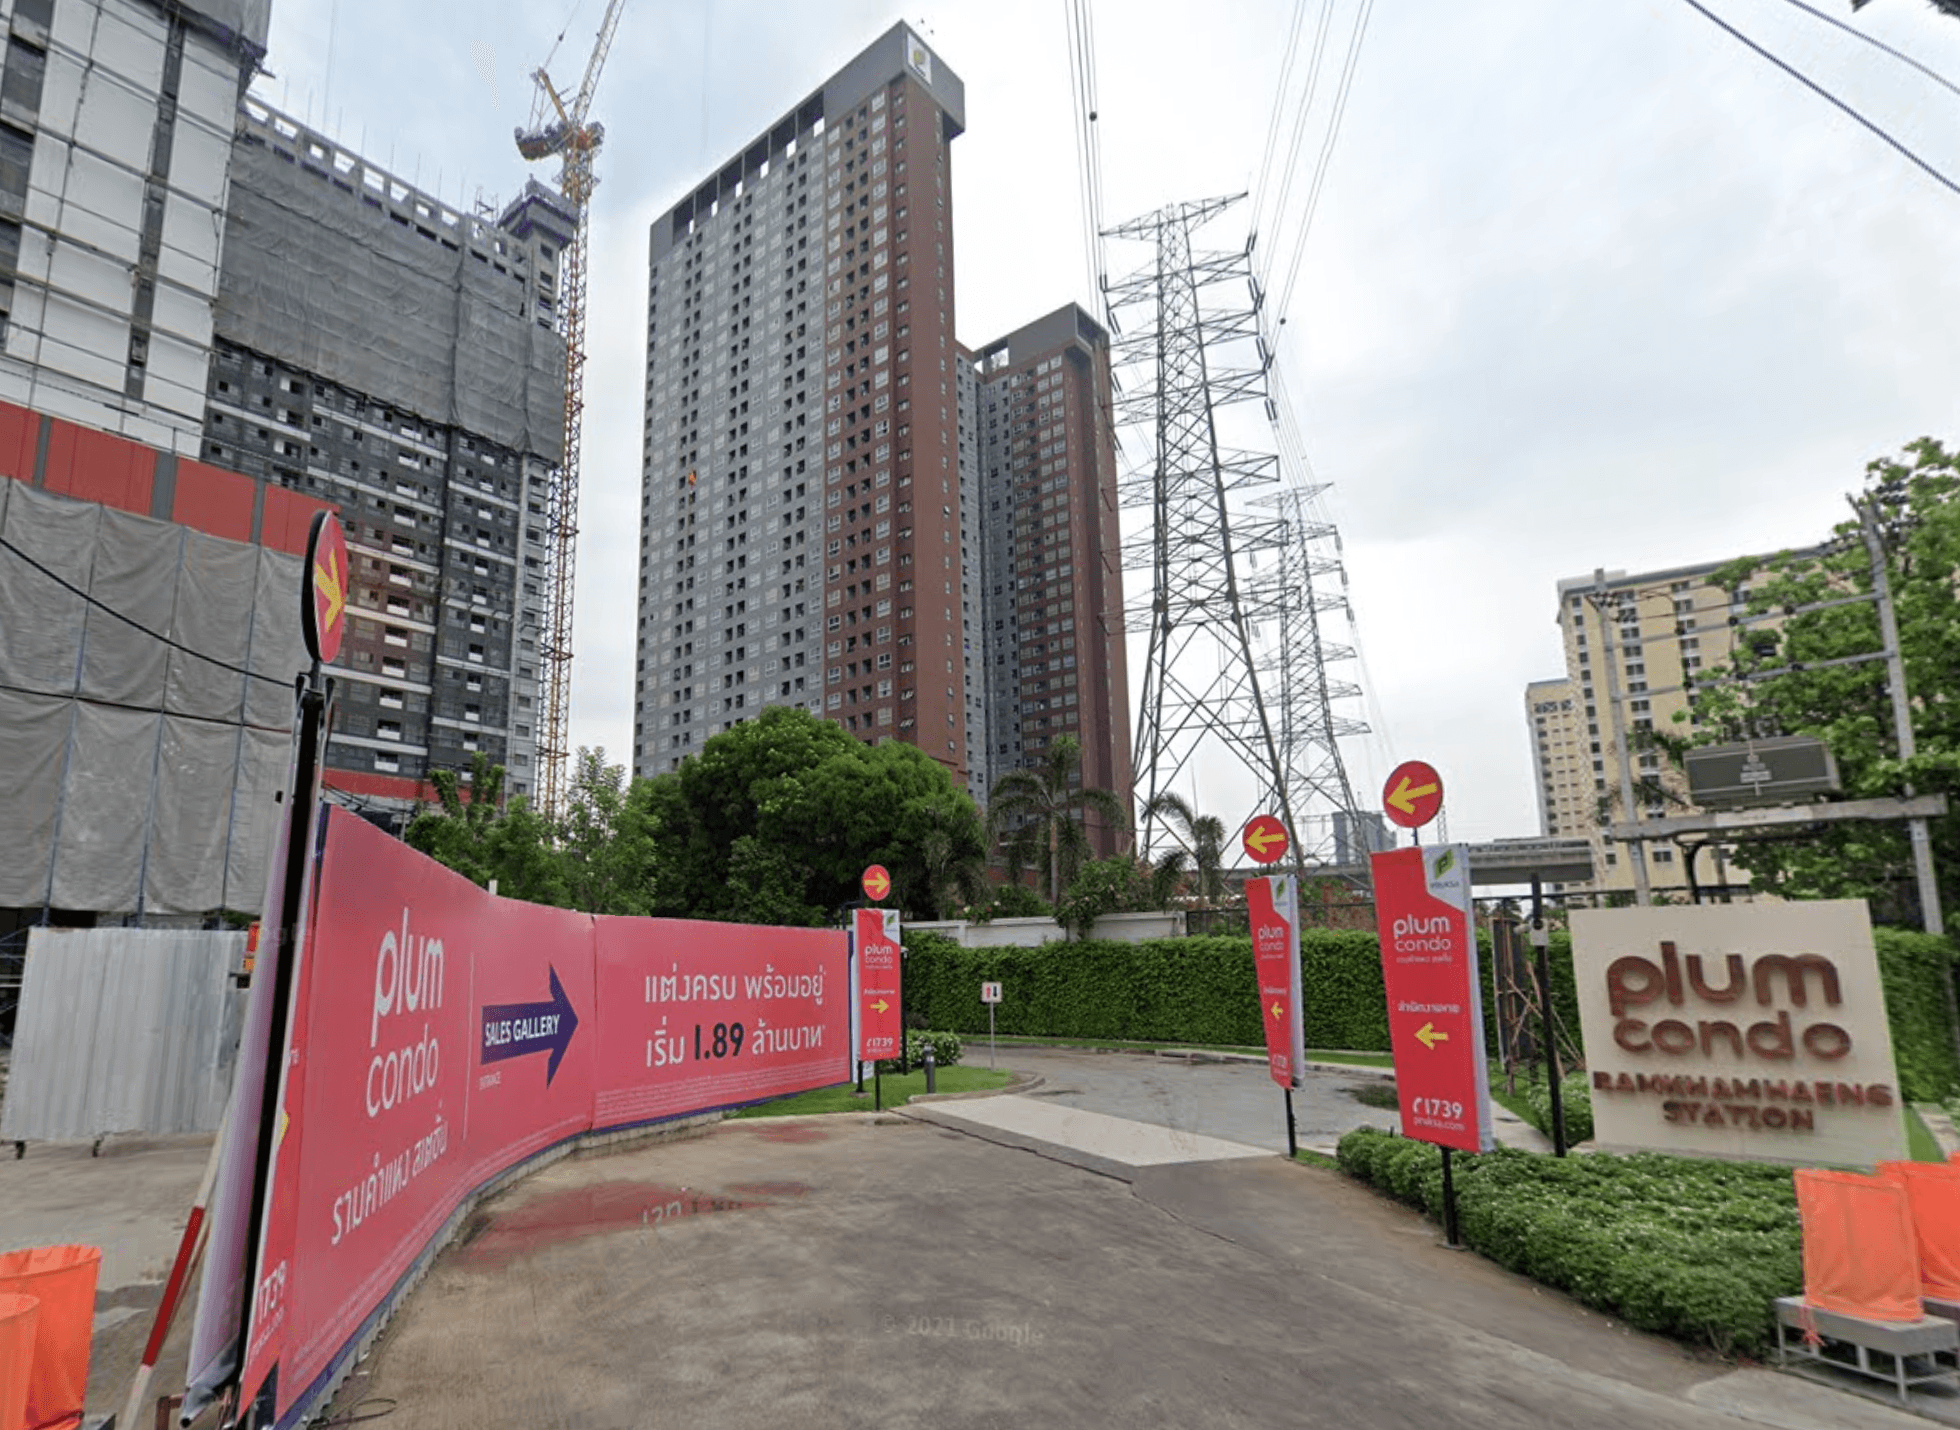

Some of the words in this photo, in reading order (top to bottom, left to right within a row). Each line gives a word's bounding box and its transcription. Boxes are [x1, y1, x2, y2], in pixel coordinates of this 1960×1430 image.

[1393, 913, 1451, 940] plum
[1394, 936, 1451, 952] condo
[865, 944, 893, 956] plum
[370, 906, 445, 1049] plum
[645, 962, 736, 1003] แต่งครบ
[1606, 940, 1843, 1017] plum
[485, 1020, 511, 1047] SALES
[513, 1014, 560, 1042] GALLERY
[646, 1015, 685, 1067] เริ่ม
[694, 1022, 744, 1060] 1.89
[1613, 1010, 1853, 1062] condo
[366, 1023, 439, 1118] condo
[1593, 1071, 1894, 1107] RAMKHAMHAENG
[1424, 1097, 1463, 1119] 1739
[1662, 1100, 1815, 1130] STATION
